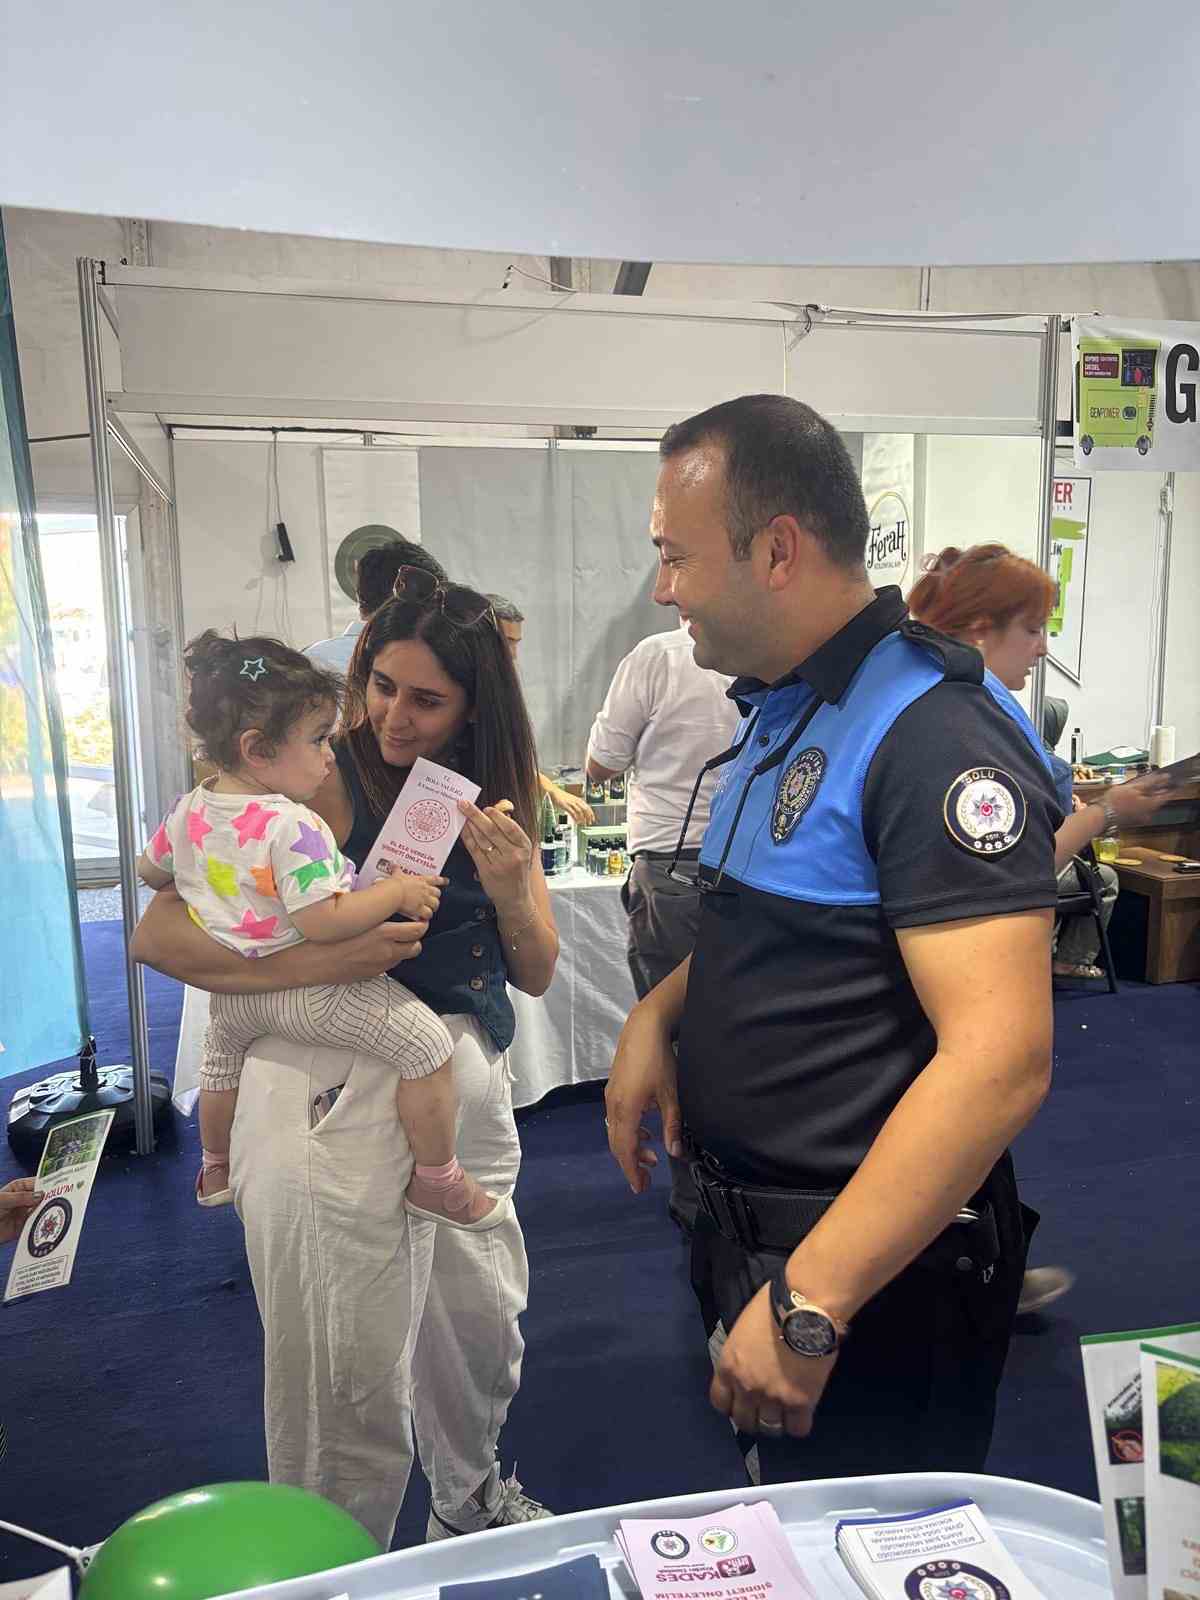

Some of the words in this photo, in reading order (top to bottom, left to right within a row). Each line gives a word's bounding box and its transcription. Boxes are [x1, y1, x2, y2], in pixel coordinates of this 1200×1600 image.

[1166, 343, 1200, 424] G
[1053, 482, 1073, 504] ER
[656, 1571, 720, 1582] KADES
